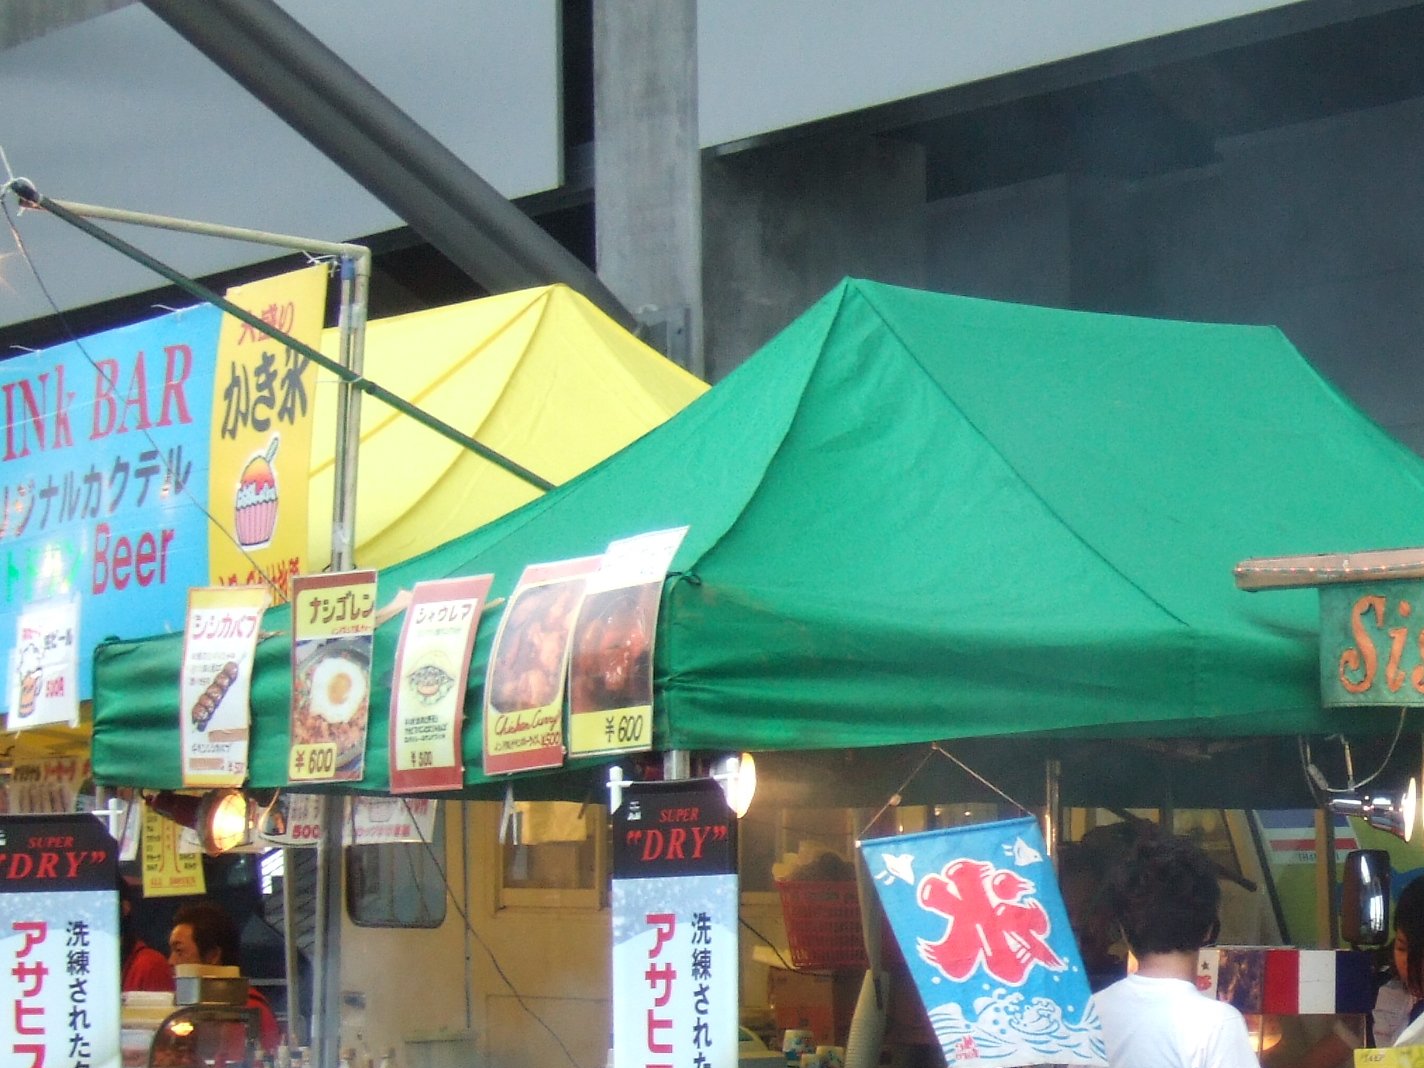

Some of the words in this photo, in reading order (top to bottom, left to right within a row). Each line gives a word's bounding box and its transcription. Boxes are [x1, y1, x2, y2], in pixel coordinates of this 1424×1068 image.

[90, 343, 193, 441] BAR
[92, 521, 176, 596] Beer
[310, 590, 375, 625] ナシゴレン
[659, 805, 700, 823] SUPER
[916, 858, 1068, 986] 氷
